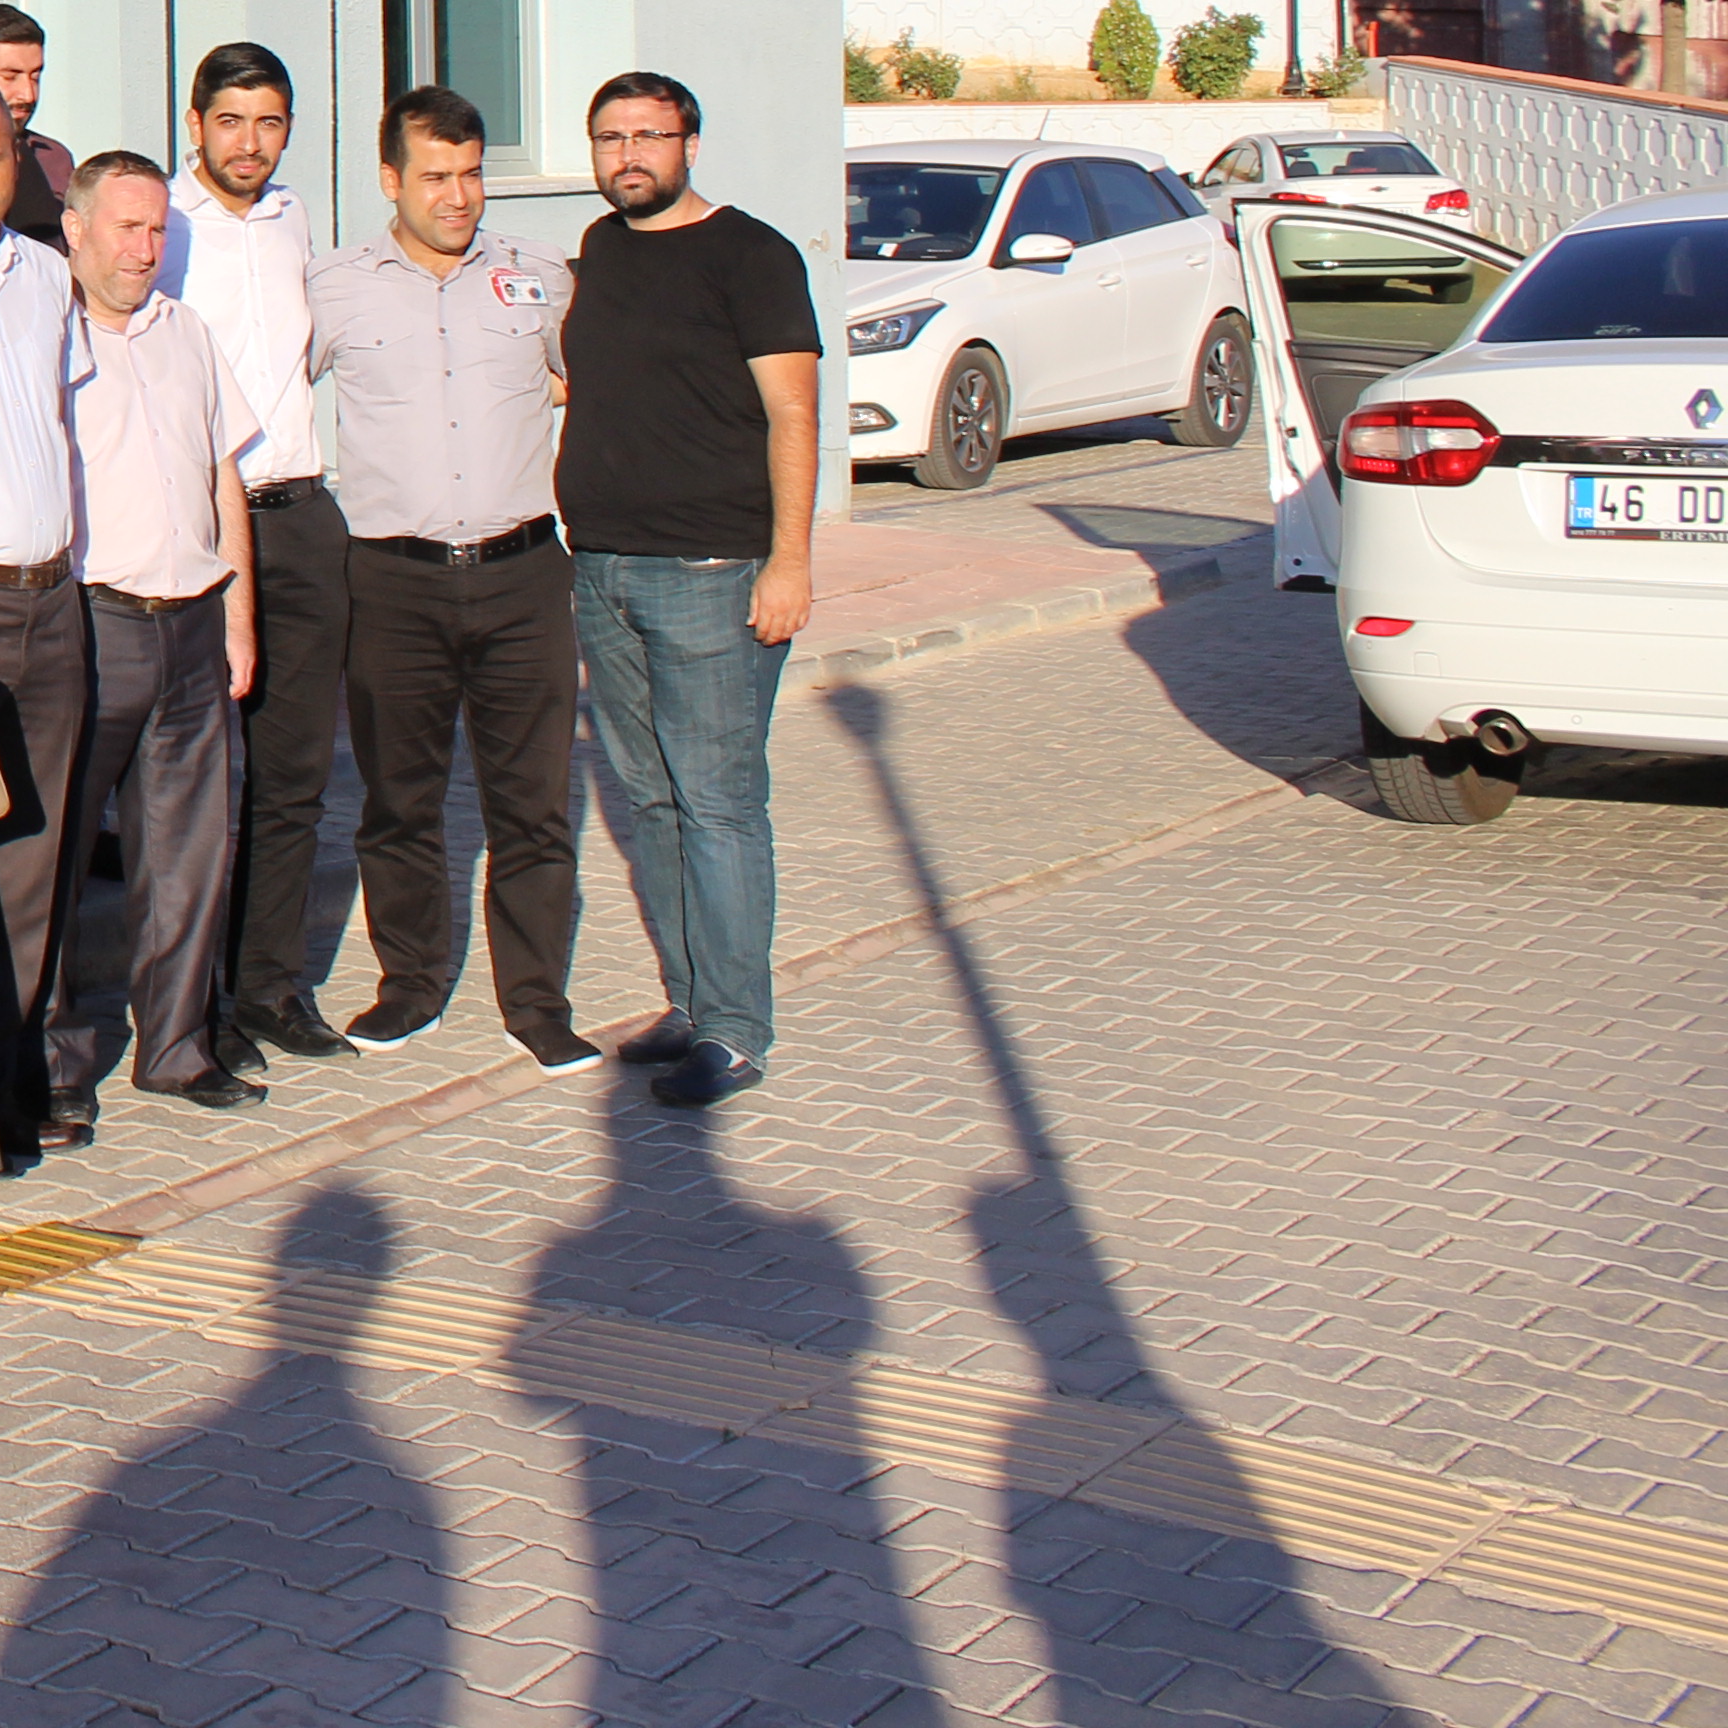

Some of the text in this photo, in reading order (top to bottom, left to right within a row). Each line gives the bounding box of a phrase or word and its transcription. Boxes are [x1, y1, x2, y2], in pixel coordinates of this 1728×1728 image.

[1600, 484, 1645, 522] 46
[1576, 507, 1593, 518] TR
[1660, 530, 1728, 542] ERTEM
